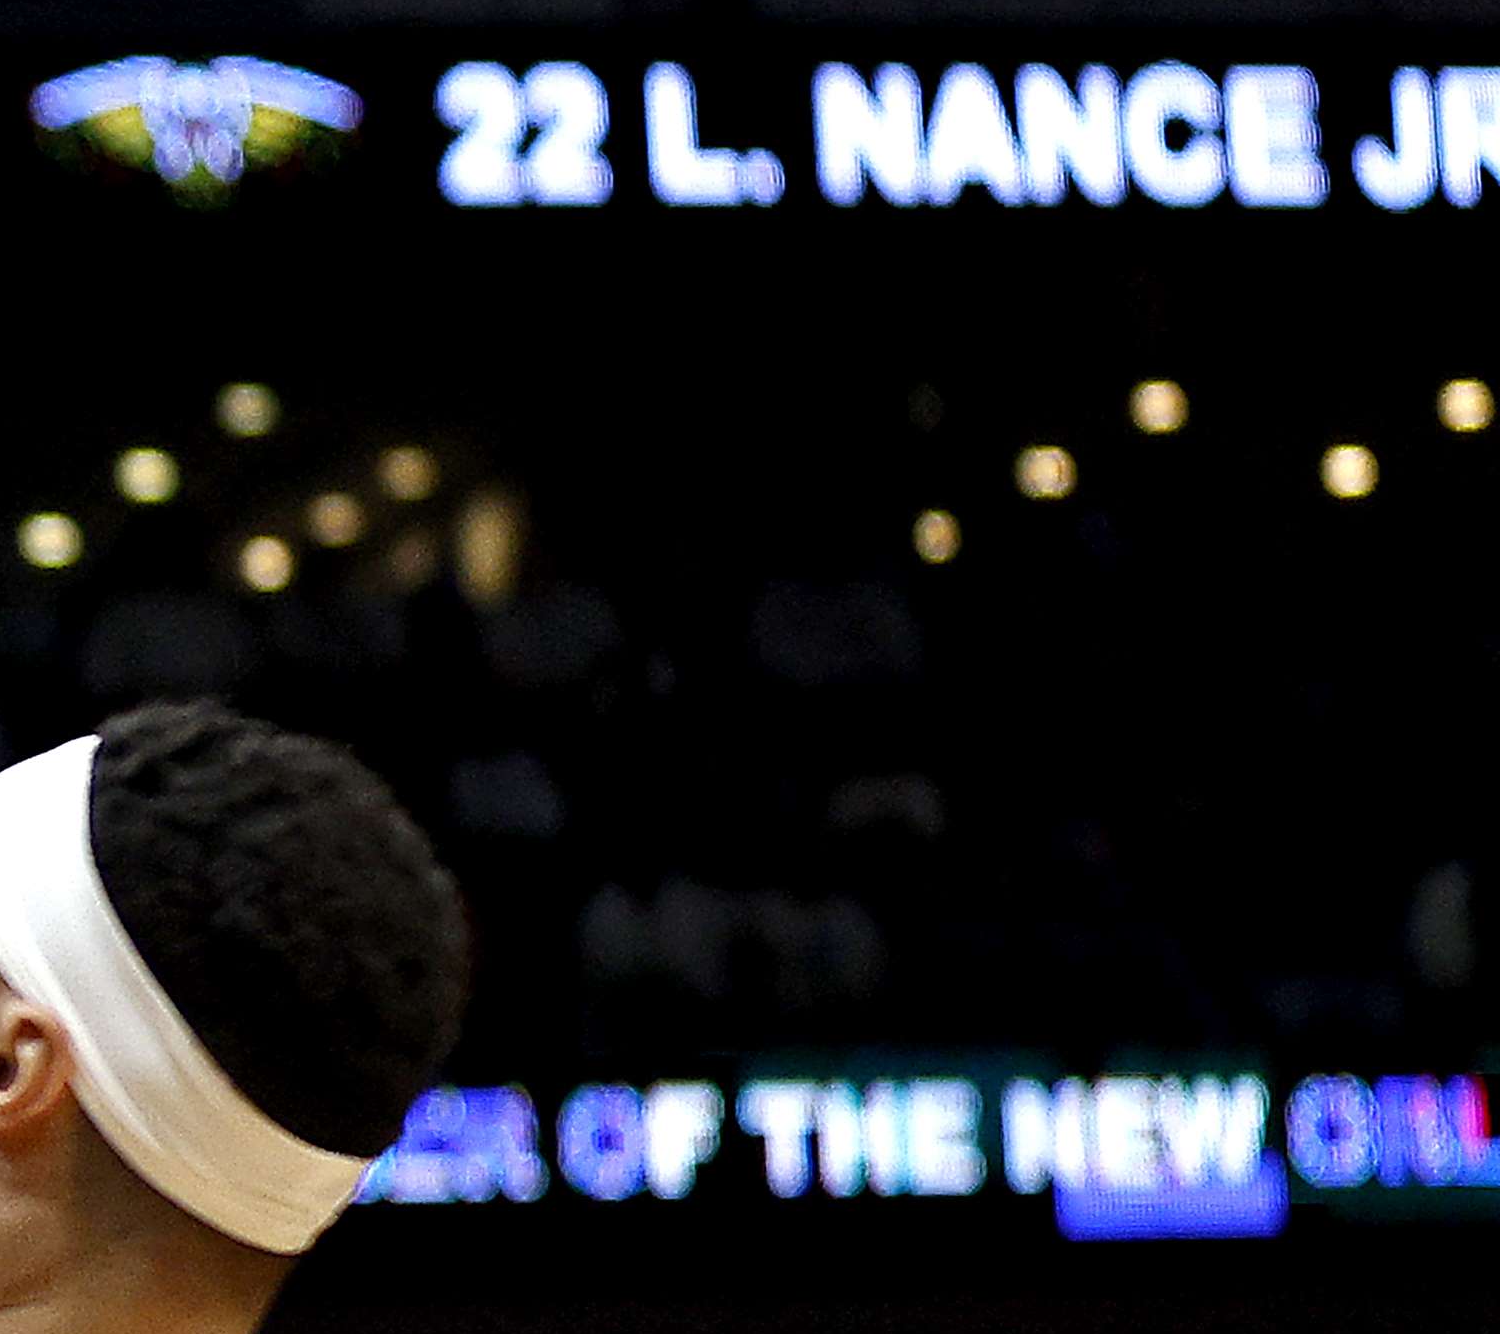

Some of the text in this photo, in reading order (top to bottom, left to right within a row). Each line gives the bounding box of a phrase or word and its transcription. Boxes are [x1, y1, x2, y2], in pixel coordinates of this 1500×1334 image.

[434, 59, 614, 208] 22
[643, 59, 786, 208] L.
[810, 57, 1330, 209] NANCE
[556, 1079, 725, 1201] OF
[734, 1077, 988, 1199] THE
[1002, 1073, 1270, 1195] NEW
